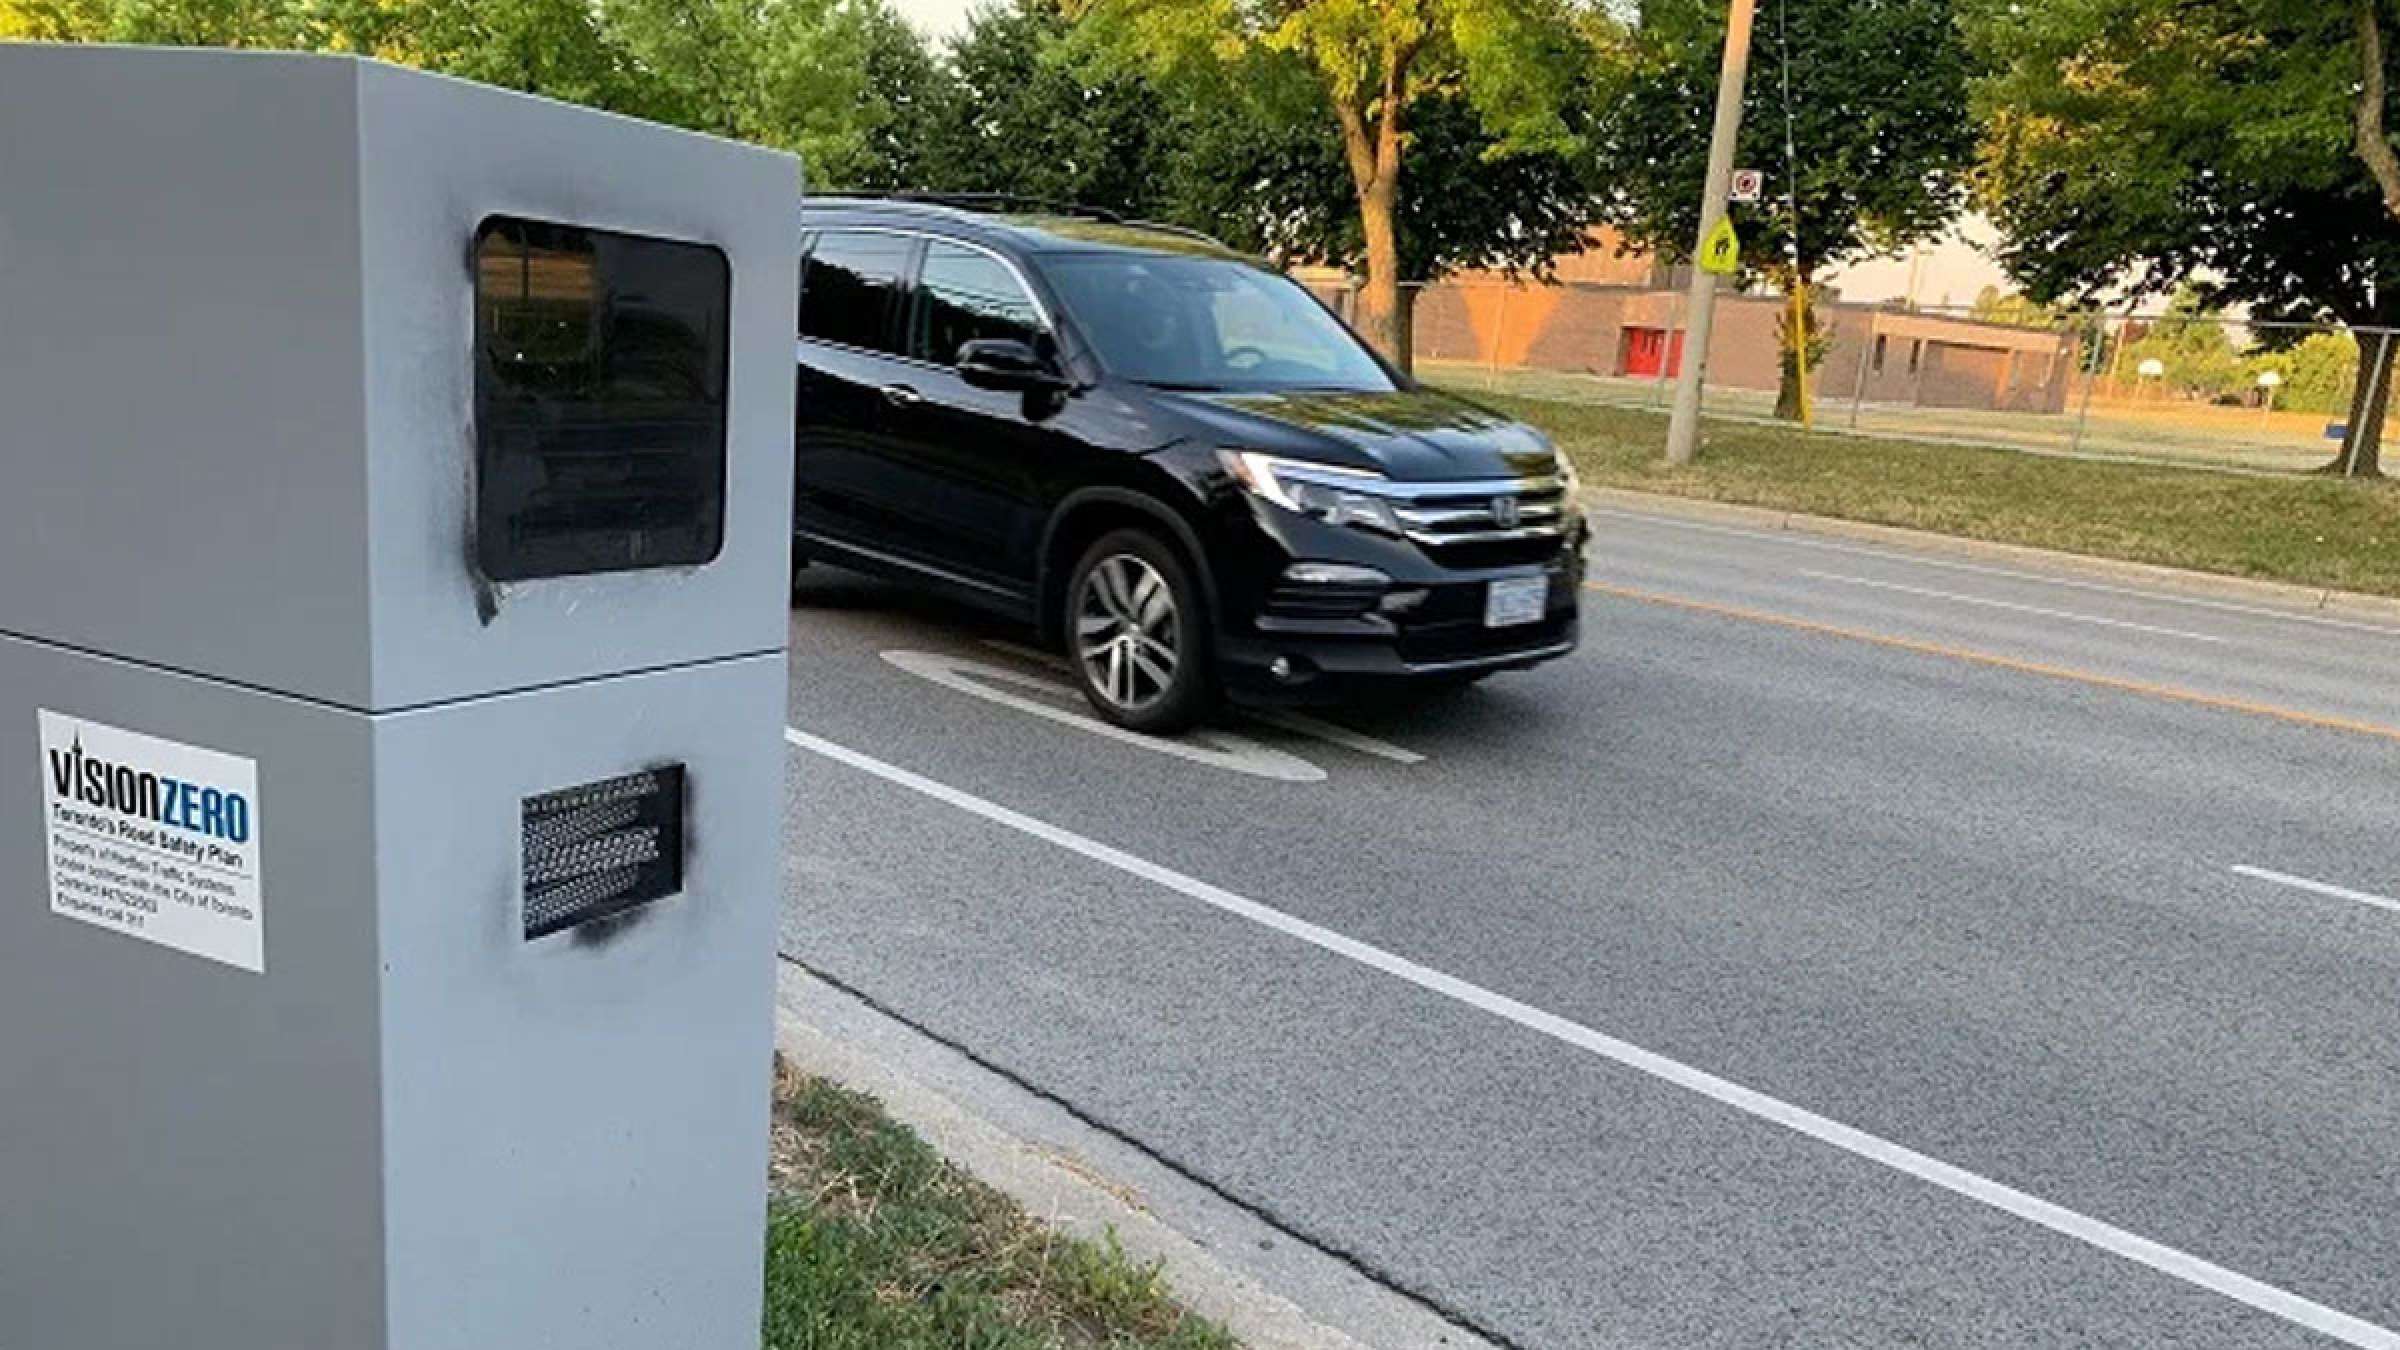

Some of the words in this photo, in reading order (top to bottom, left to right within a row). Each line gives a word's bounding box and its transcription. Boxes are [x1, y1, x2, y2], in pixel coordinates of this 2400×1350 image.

[53, 803, 116, 834] Toronto's
[119, 820, 155, 846] Road
[160, 831, 204, 863] Safety
[207, 844, 243, 868] Plan
